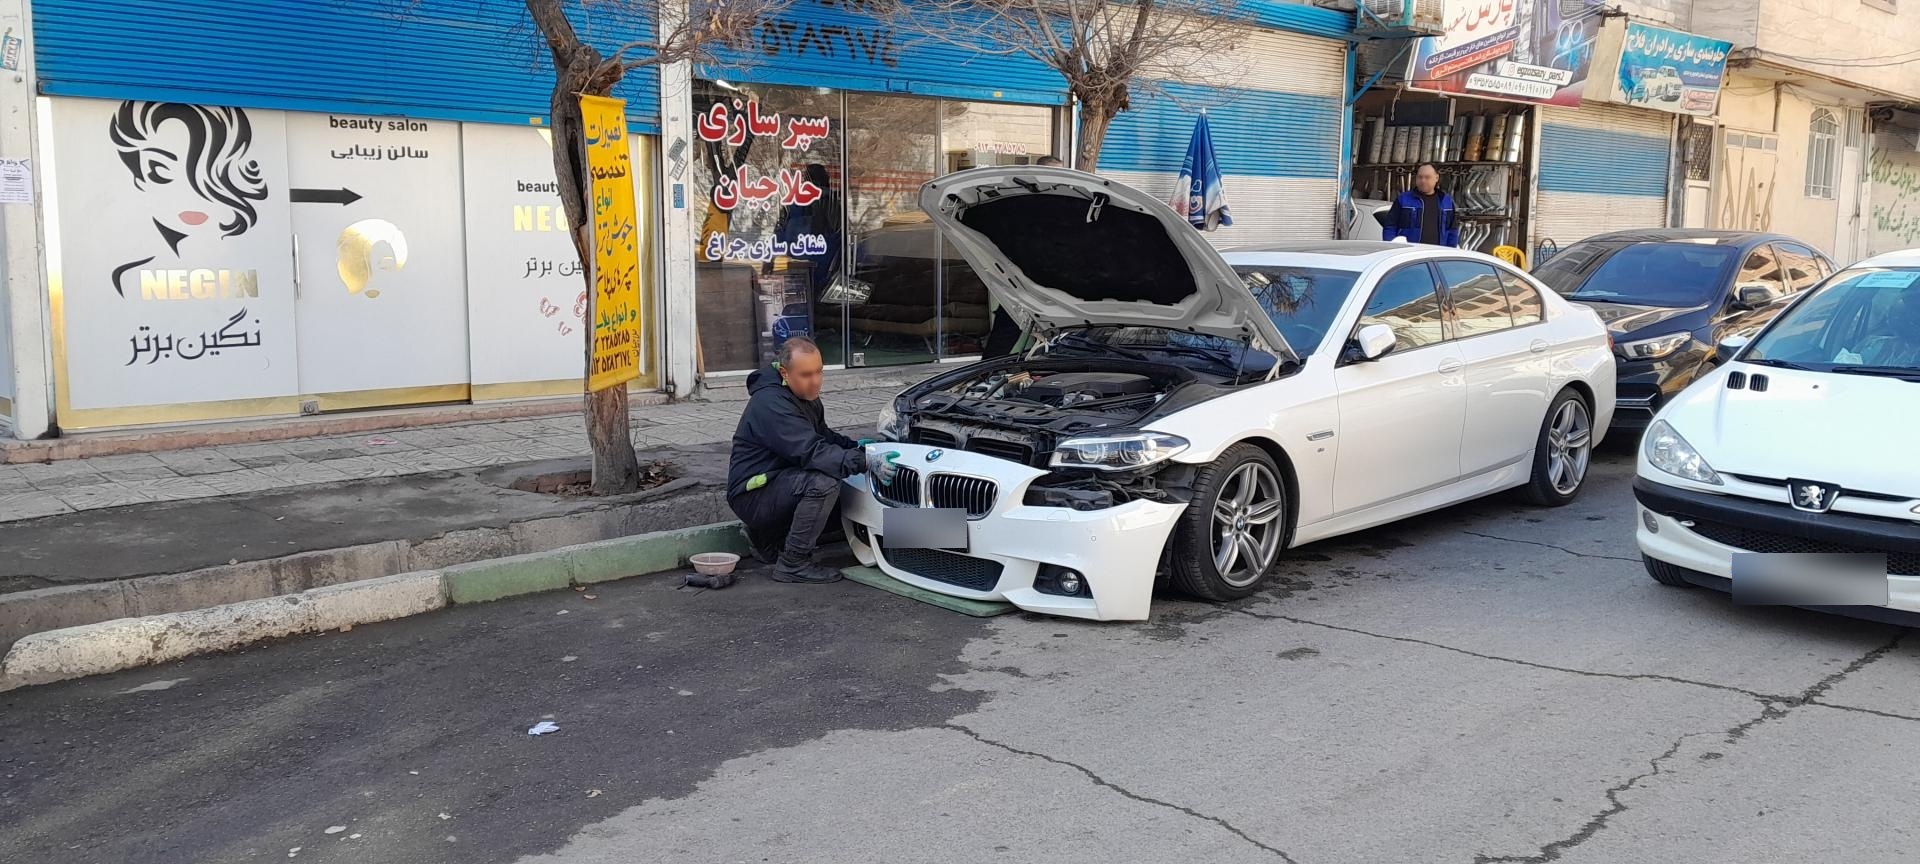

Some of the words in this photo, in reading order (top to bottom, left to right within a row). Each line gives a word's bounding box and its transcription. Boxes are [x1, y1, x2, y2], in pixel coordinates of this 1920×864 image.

[1643, 34, 1674, 58] برادران
[1674, 40, 1695, 62] سازی
[329, 115, 382, 133] beauty
[388, 119, 428, 132] salon
[585, 114, 623, 148] تعمیرات
[698, 99, 780, 146] سازی
[782, 115, 829, 151] سپر
[330, 144, 382, 160] زیبایی
[387, 145, 429, 161] سالن
[596, 187, 612, 215] انواع
[714, 164, 822, 210] حلاجیان
[706, 231, 747, 260] چراغ
[749, 234, 788, 262] سازی
[790, 233, 827, 256] شفاف
[522, 257, 552, 279] برتر
[140, 268, 259, 301] NEGIN
[611, 301, 628, 332] انواع
[630, 309, 636, 323] و
[125, 326, 173, 366] برتر
[176, 306, 261, 360] نگین
